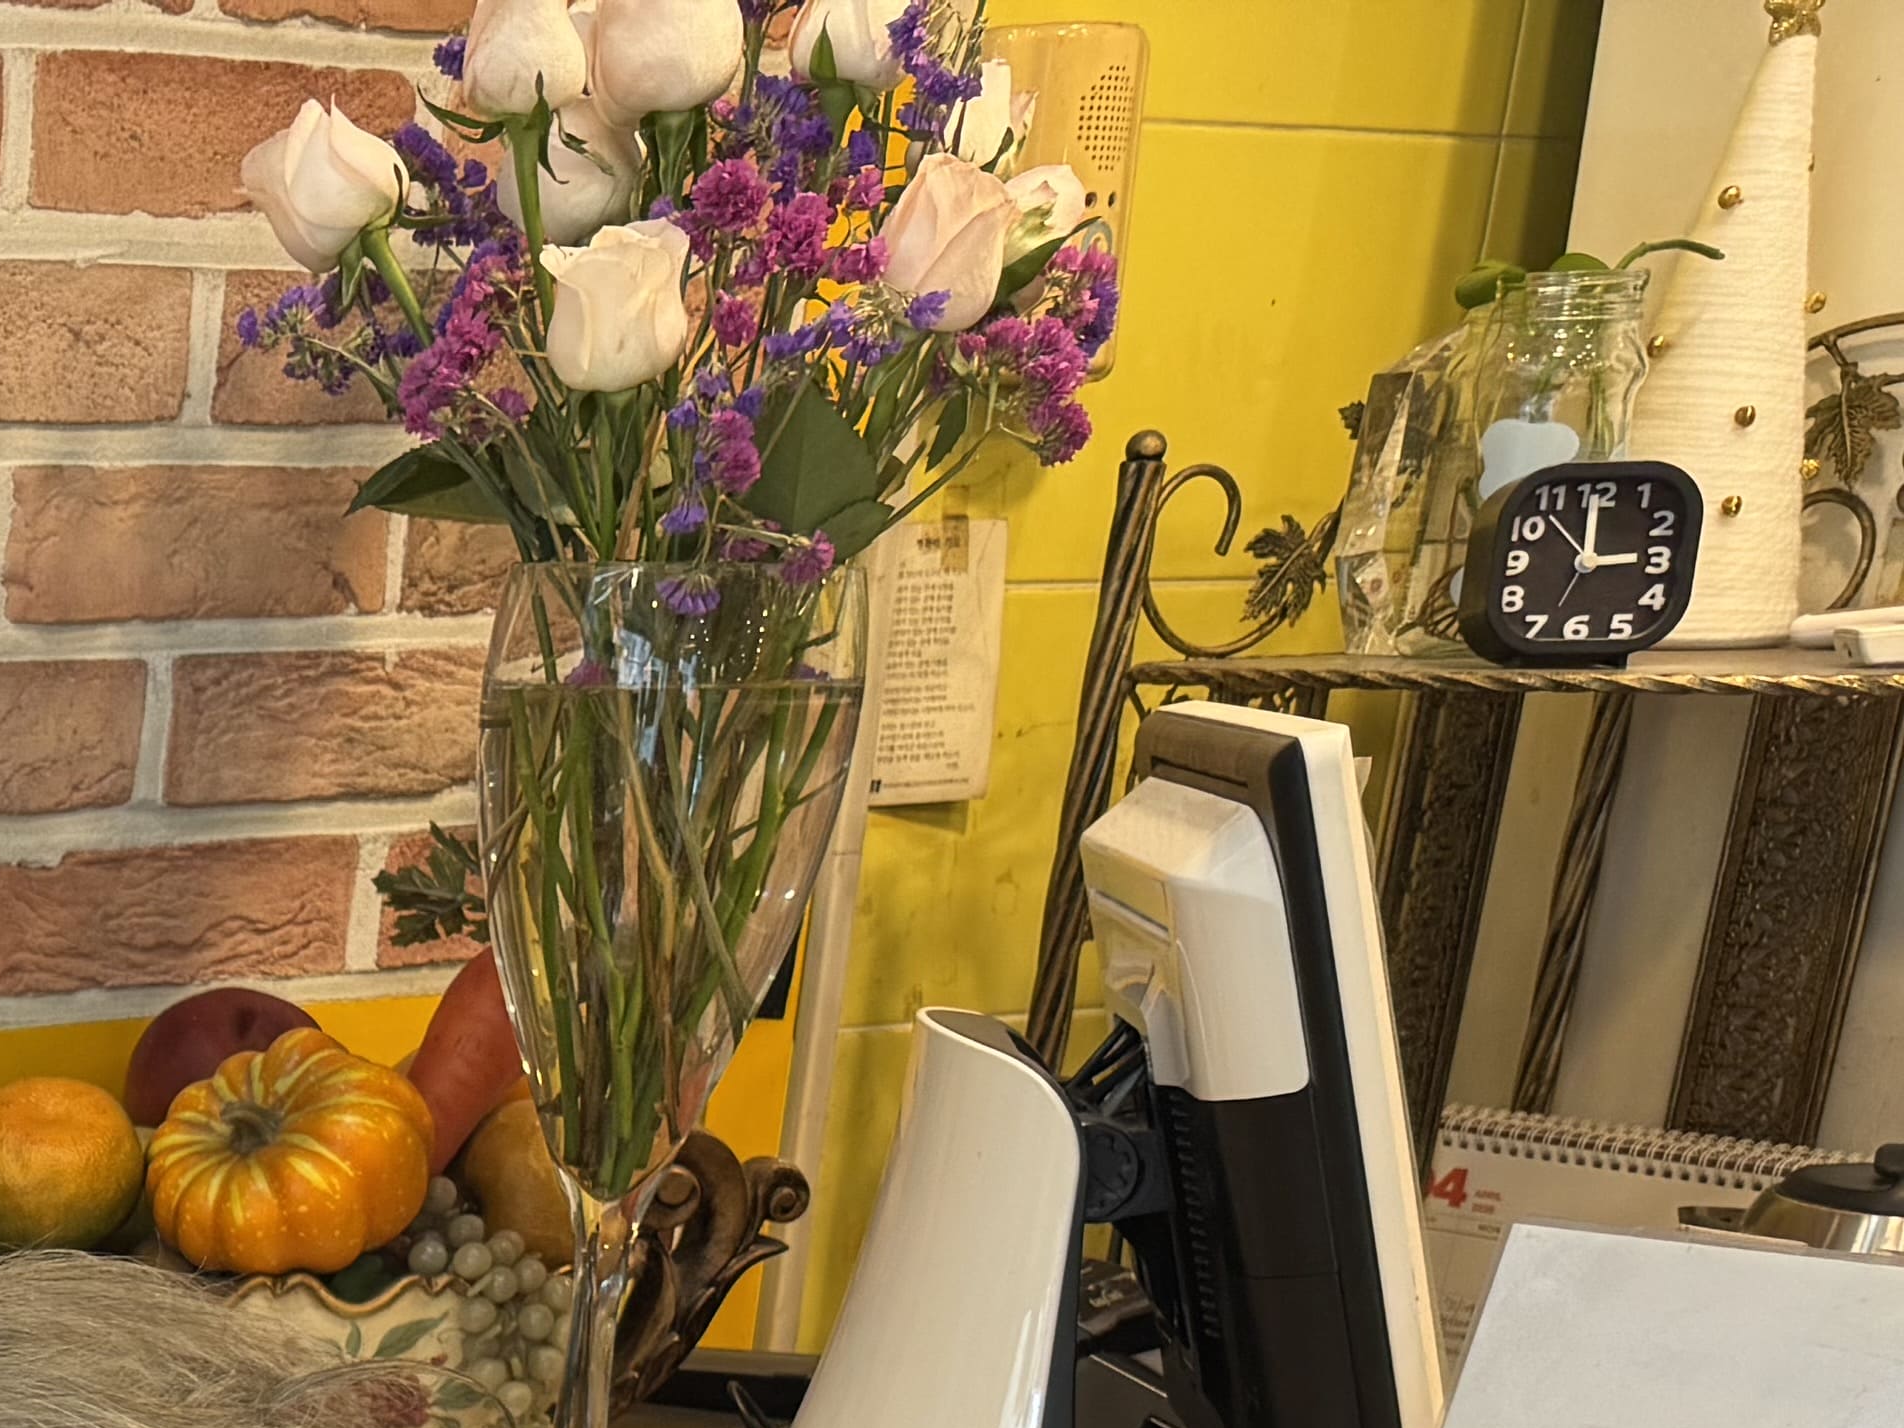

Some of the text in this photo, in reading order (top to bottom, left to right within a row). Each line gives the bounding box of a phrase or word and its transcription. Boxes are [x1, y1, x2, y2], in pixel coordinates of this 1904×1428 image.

[1535, 484, 1571, 510] 11
[1576, 481, 1618, 508] 12
[1636, 483, 1652, 508] 1
[1511, 515, 1544, 542] 10
[1649, 511, 1675, 537] 2
[1506, 551, 1530, 576] 9
[1646, 547, 1671, 575] 3
[1502, 585, 1524, 612] 8
[1637, 583, 1666, 611] 4
[1525, 615, 1549, 640] 7
[1563, 615, 1588, 640] 6
[1607, 613, 1634, 639] 5
